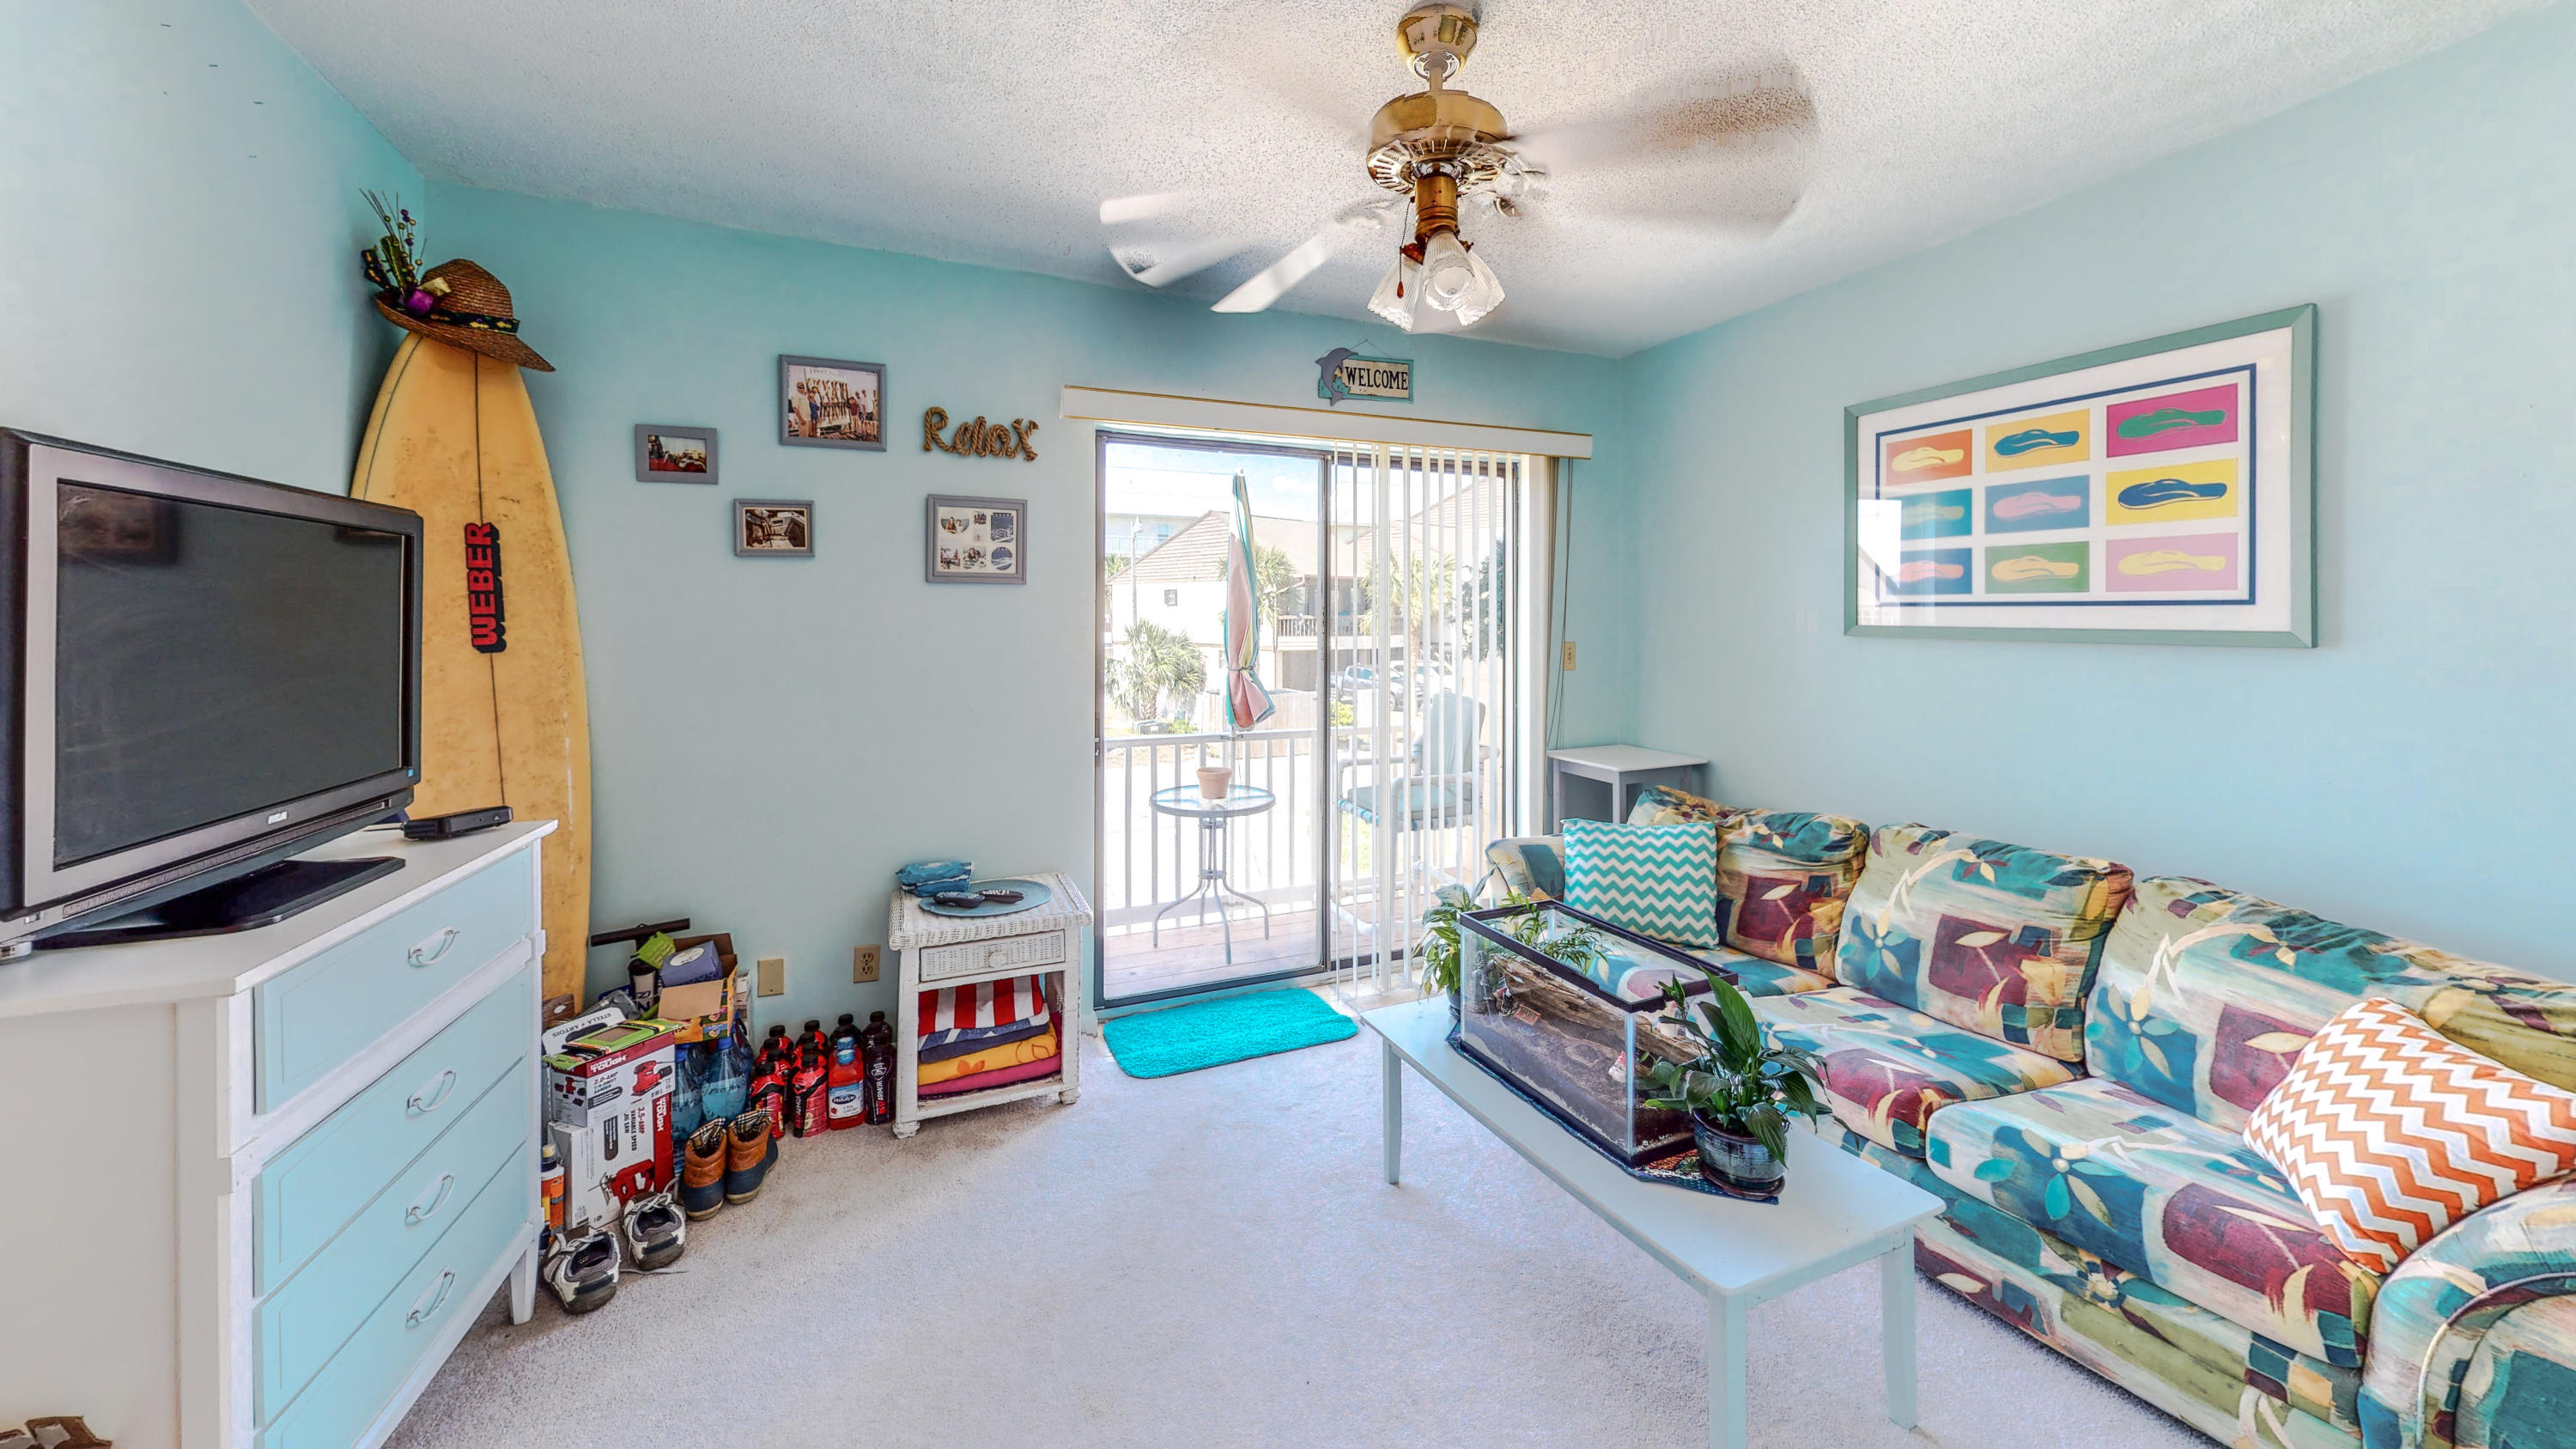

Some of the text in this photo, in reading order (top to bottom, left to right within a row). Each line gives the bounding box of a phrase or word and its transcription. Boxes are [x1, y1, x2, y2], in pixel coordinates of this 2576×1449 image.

[1345, 366, 1408, 391] WELCOME
[923, 405, 1039, 462] Relax
[465, 521, 502, 650] WEBER
[552, 1013, 611, 1038] STELLA ARTOIS
[591, 1054, 628, 1073] TOUGH
